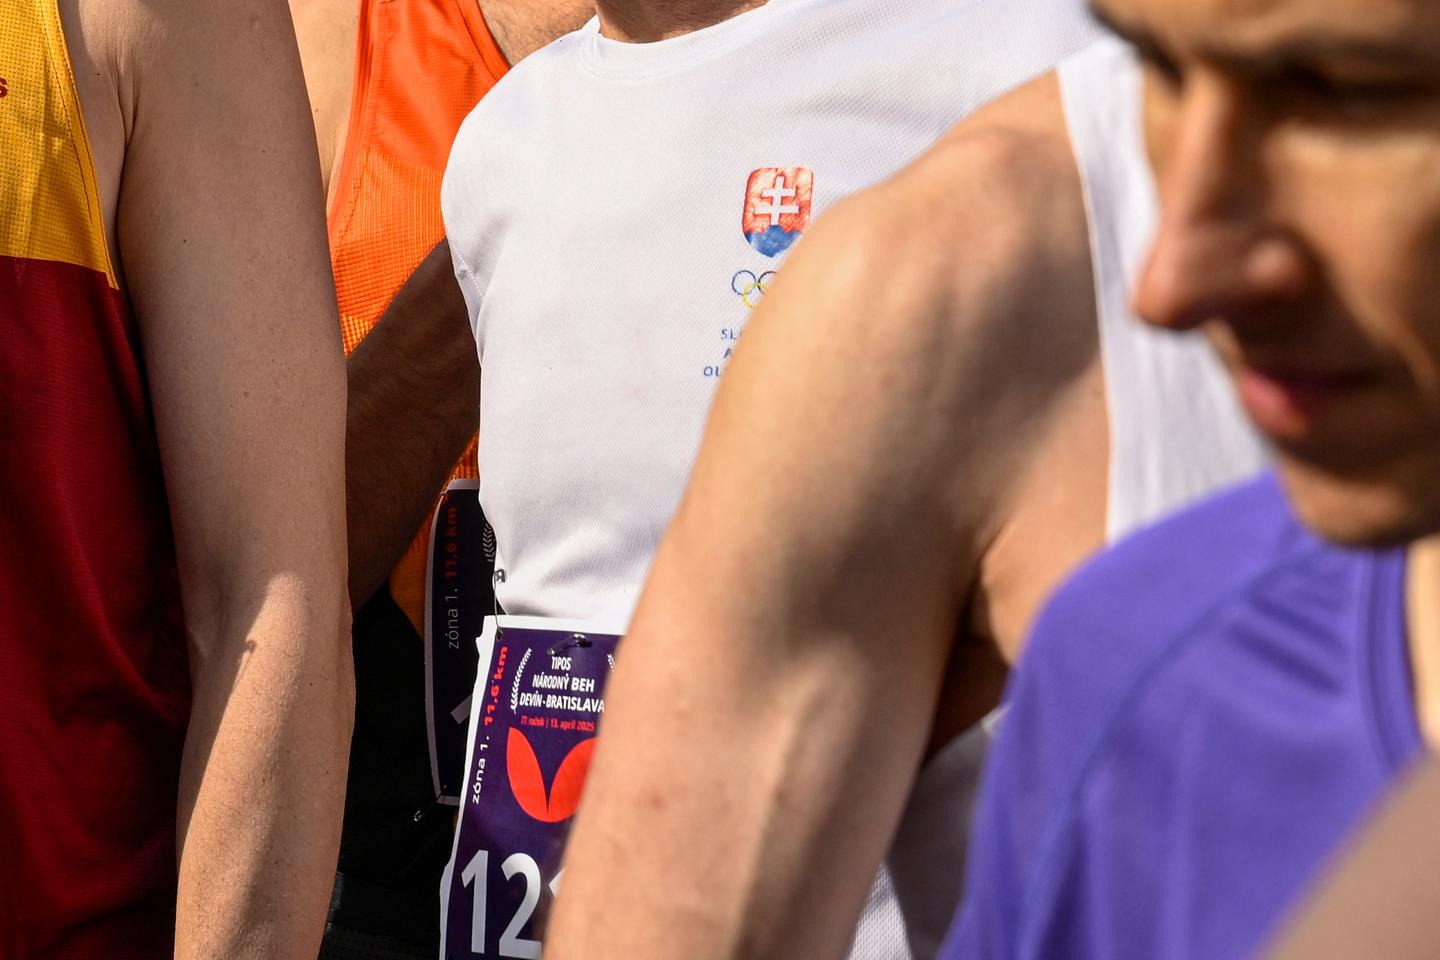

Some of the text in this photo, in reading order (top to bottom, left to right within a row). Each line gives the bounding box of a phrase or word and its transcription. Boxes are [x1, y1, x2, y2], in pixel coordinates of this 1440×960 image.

[445, 608, 460, 650] zóna
[551, 656, 572, 671] TIPOS
[532, 671, 595, 692] NÁRODNÝ BEH
[519, 690, 543, 707] DEVÍN
[546, 694, 605, 712] BRATISLAVA
[472, 758, 486, 805] zóna
[480, 735, 490, 751] 1.
[493, 645, 508, 680] km
[461, 849, 566, 960] 12
